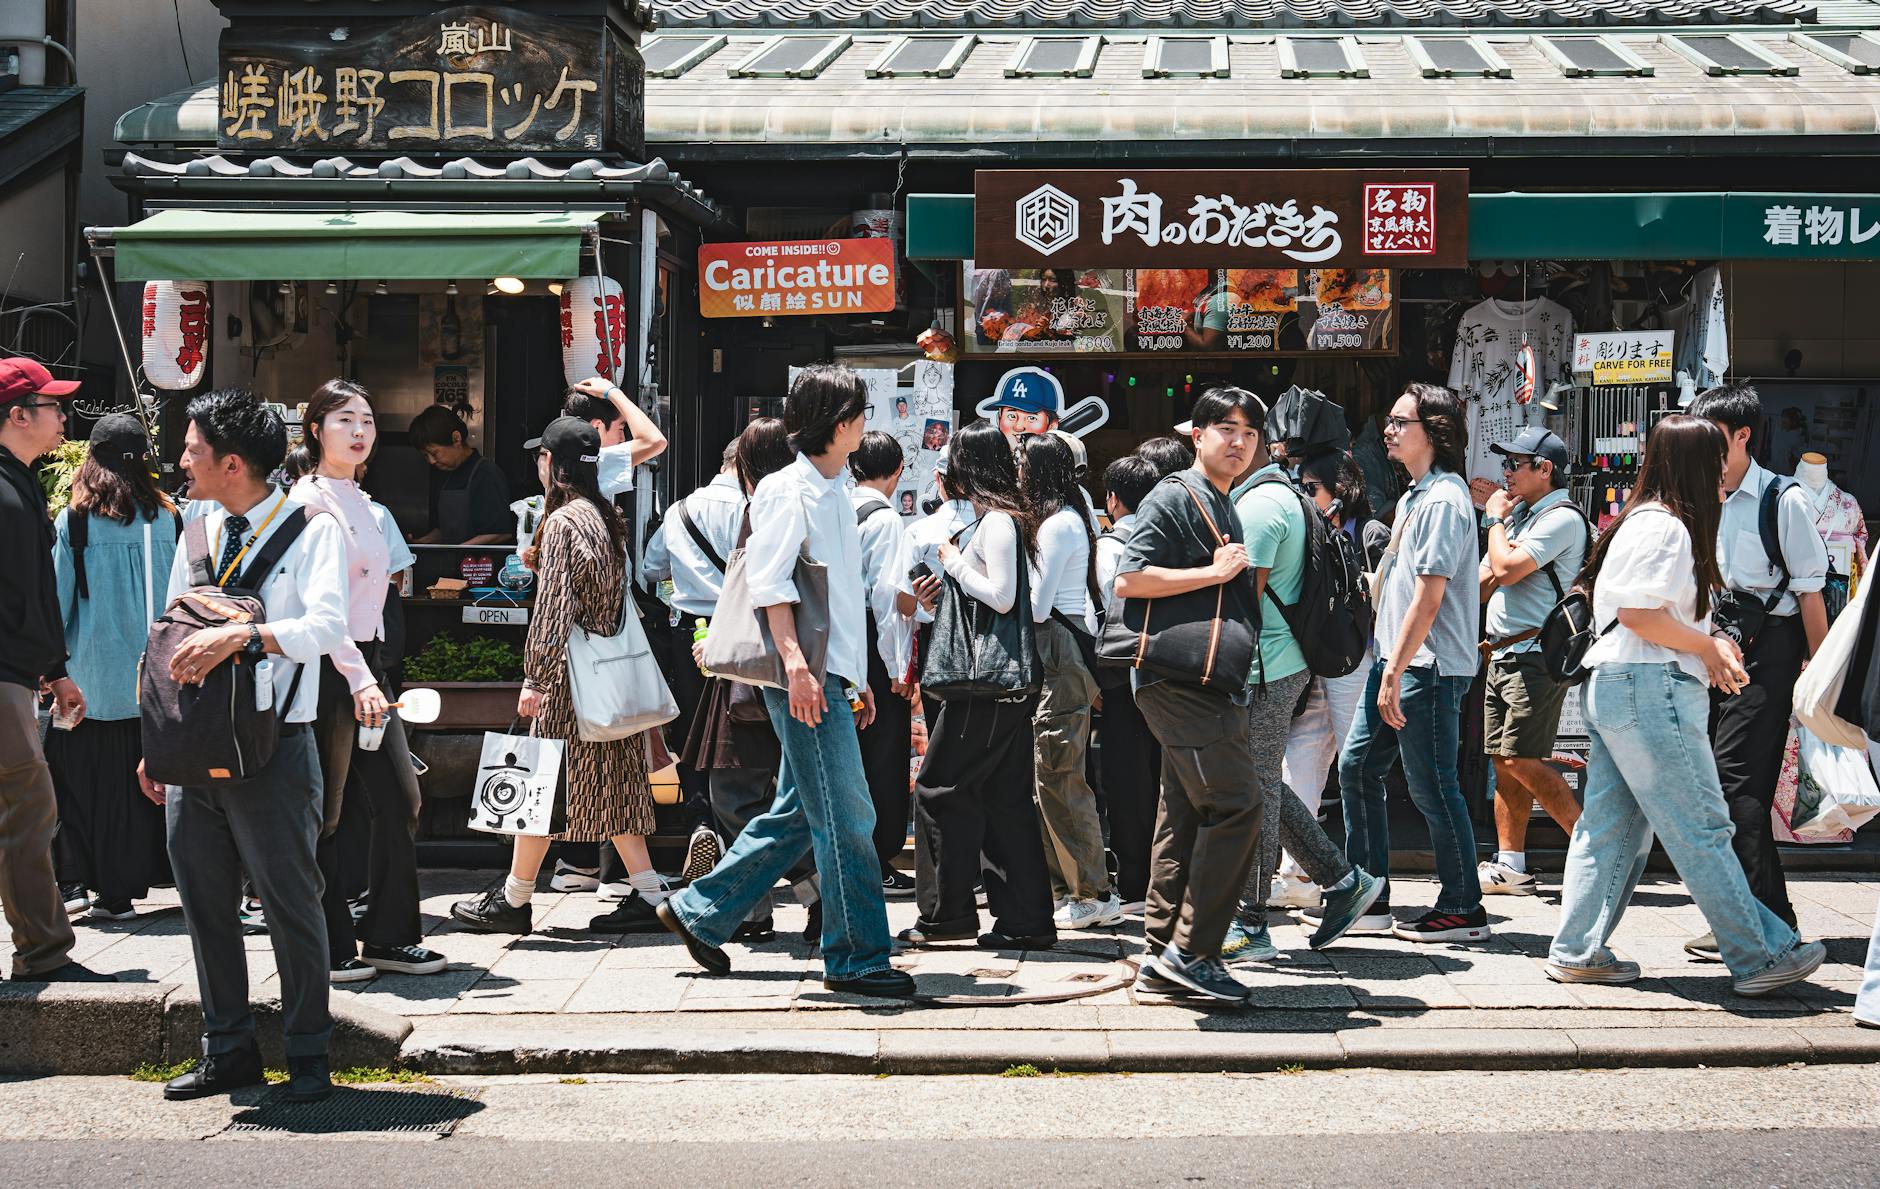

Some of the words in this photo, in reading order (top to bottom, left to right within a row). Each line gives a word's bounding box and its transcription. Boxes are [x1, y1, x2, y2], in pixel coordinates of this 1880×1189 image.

[436, 22, 511, 54] 嵐山
[222, 64, 598, 144] 嵯峨野コロッケ
[1370, 189, 1427, 213] 名物
[1099, 179, 1342, 262] 肉のおだきち
[1368, 216, 1430, 233] 京風特大
[1763, 205, 1880, 245] 着物レ
[1369, 233, 1429, 249] せんべい
[745, 246, 778, 257] COME
[781, 243, 826, 255] INSIDE!!
[705, 259, 890, 291] Caricature
[1228, 303, 1254, 317] 和牛
[1317, 302, 1344, 316] 和牛
[1138, 336, 1183, 351] ¥1,000
[1227, 335, 1271, 349] ¥1,200
[1317, 334, 1362, 348] ¥1,500
[1594, 360, 1624, 370] CARVE
[1627, 360, 1646, 369] FOR
[1648, 358, 1672, 368] FREE
[436, 388, 468, 404] 765
[1012, 378, 1028, 398] LA
[480, 610, 508, 623] OPEN
